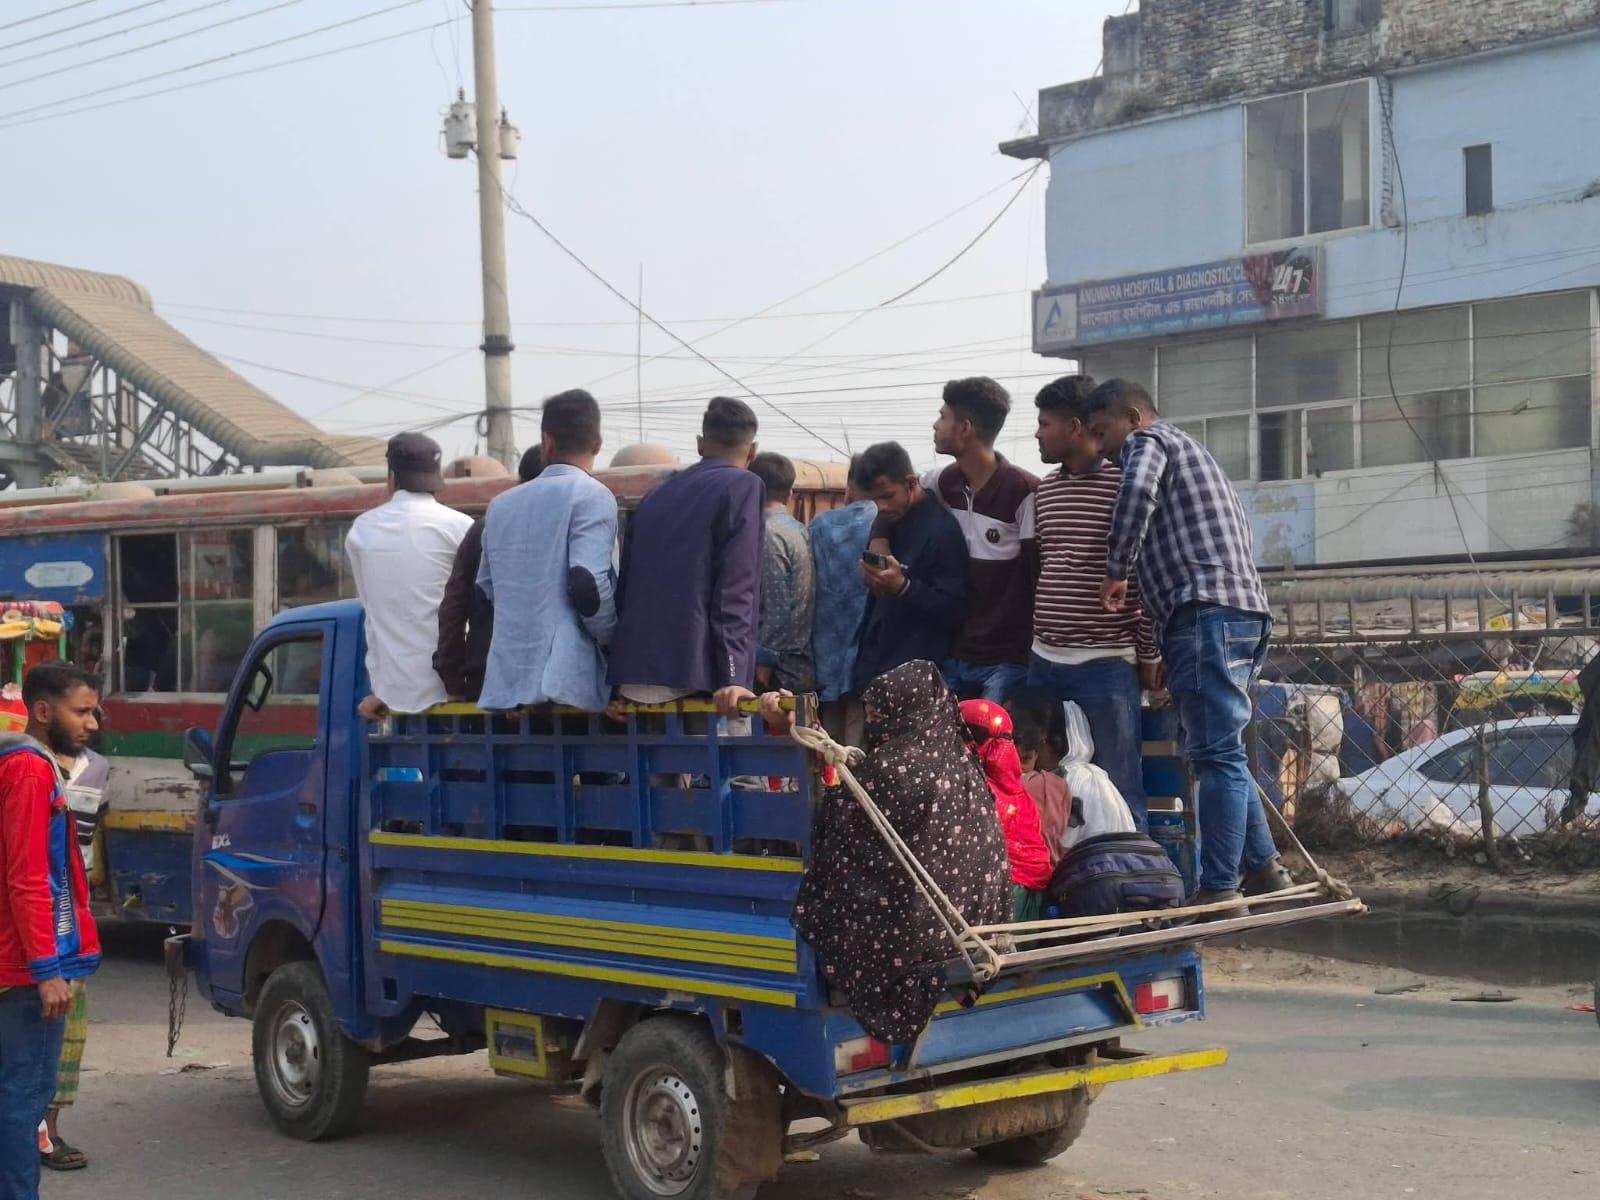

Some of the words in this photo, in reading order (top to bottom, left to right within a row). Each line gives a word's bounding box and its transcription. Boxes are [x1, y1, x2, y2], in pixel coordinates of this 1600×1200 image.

[1123, 276, 1166, 299] HOSPITAL
[1167, 274, 1175, 293] &
[1176, 266, 1232, 291] DIAGNOSTIC
